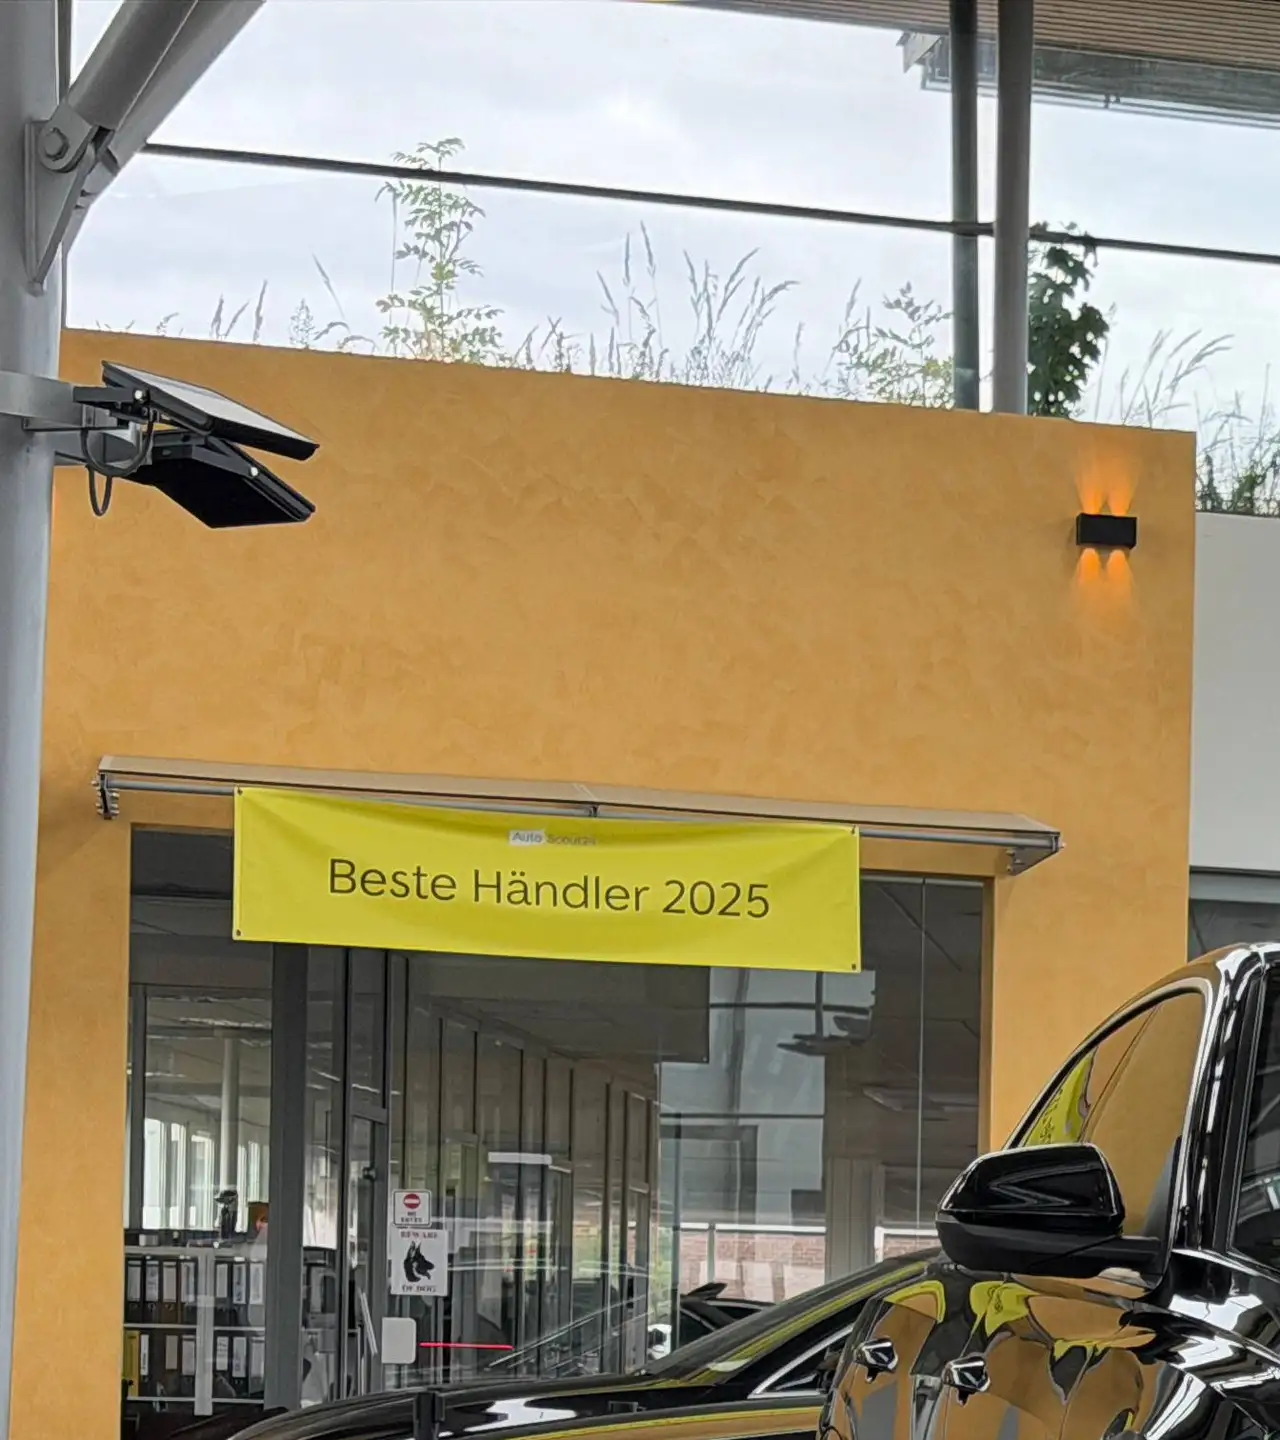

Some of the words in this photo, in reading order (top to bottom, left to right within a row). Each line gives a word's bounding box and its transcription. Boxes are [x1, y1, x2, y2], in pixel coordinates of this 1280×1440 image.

[329, 857, 457, 901] Beste
[473, 869, 649, 912] Händler
[662, 879, 770, 919] 2025
